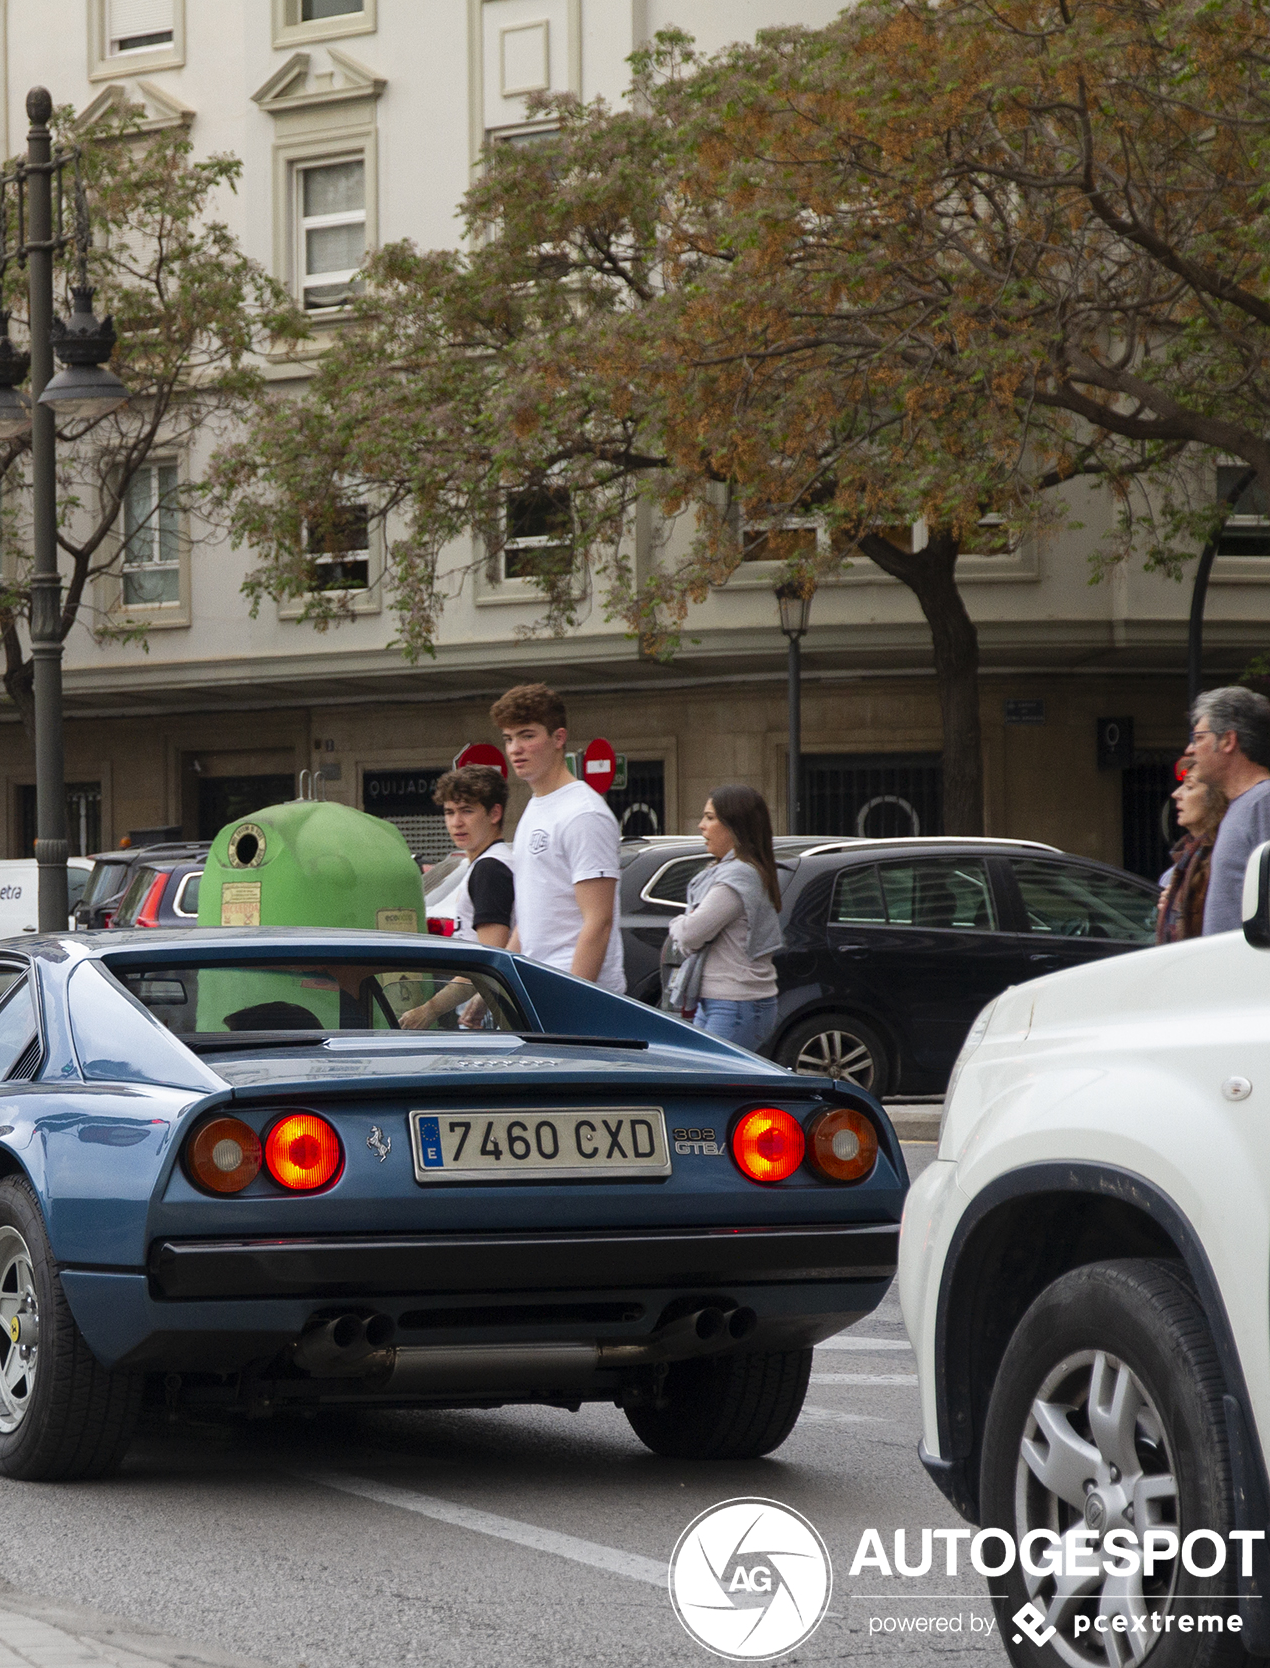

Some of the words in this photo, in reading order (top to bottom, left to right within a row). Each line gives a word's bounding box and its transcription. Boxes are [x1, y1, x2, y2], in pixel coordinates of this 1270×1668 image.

[0, 884, 22, 900] etra
[449, 1120, 560, 1161] 7460
[575, 1119, 655, 1159] CXD
[673, 1128, 716, 1141] 308
[428, 1148, 437, 1159] E
